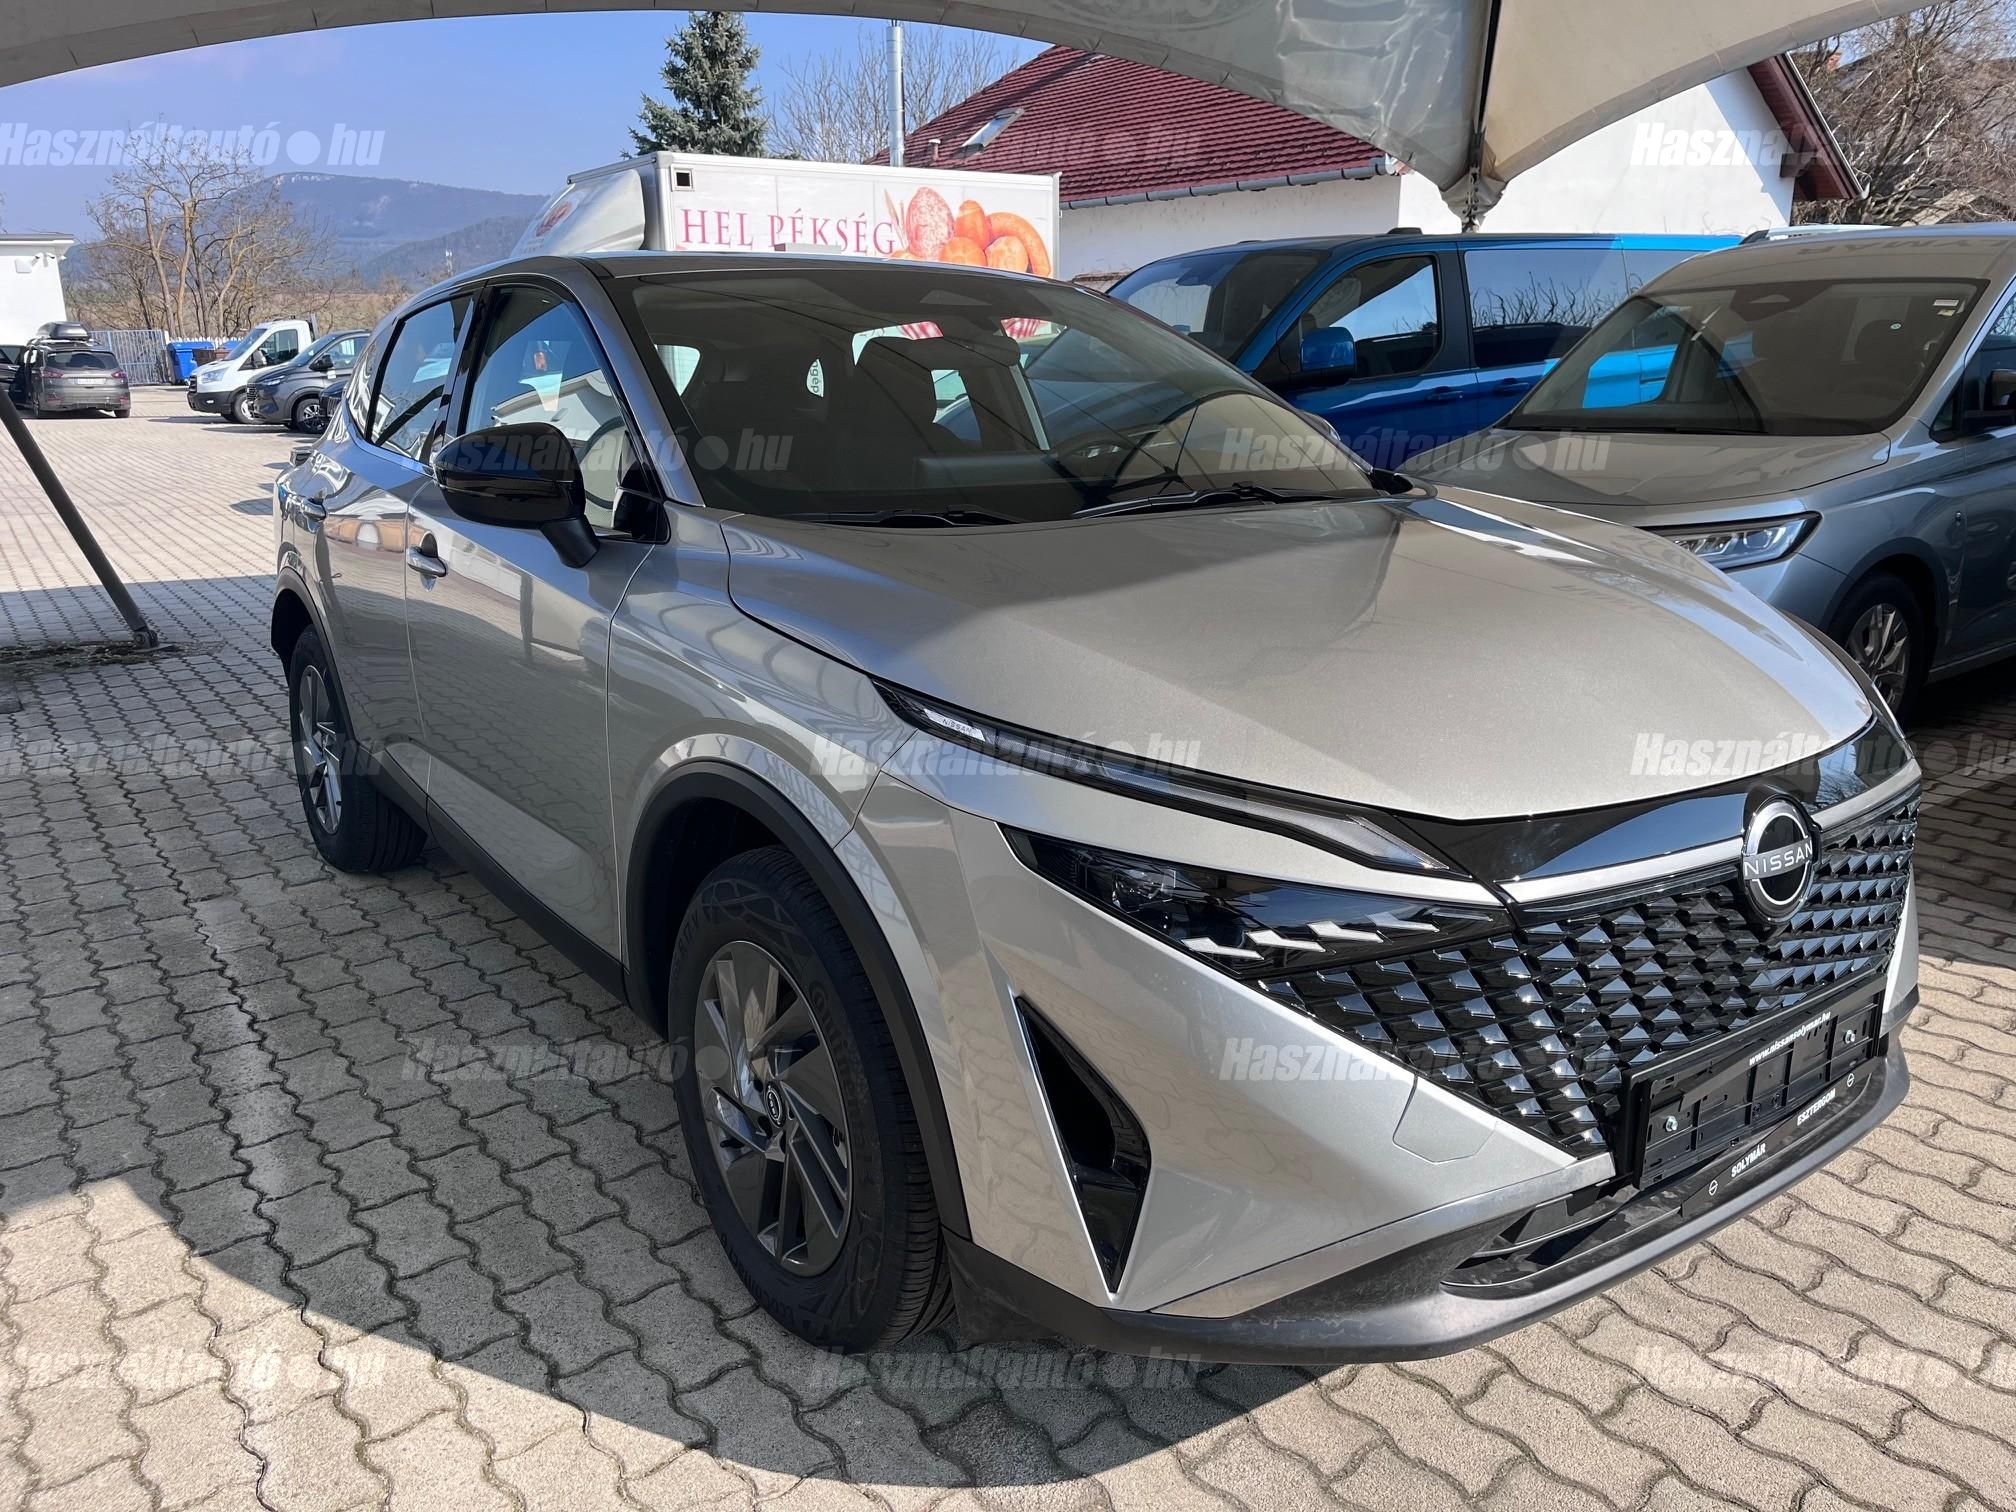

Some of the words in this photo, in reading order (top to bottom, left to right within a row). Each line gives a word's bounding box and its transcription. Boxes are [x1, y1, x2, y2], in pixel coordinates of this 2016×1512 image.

[681, 208, 752, 246] HEL
[768, 208, 895, 255] PÉKSÉG
[942, 719, 972, 733] NISSAN
[1744, 840, 1813, 876] NISSAN
[1797, 1088, 1836, 1126] ESZTERGOM
[1731, 1143, 1766, 1177] SOLYMÁR
